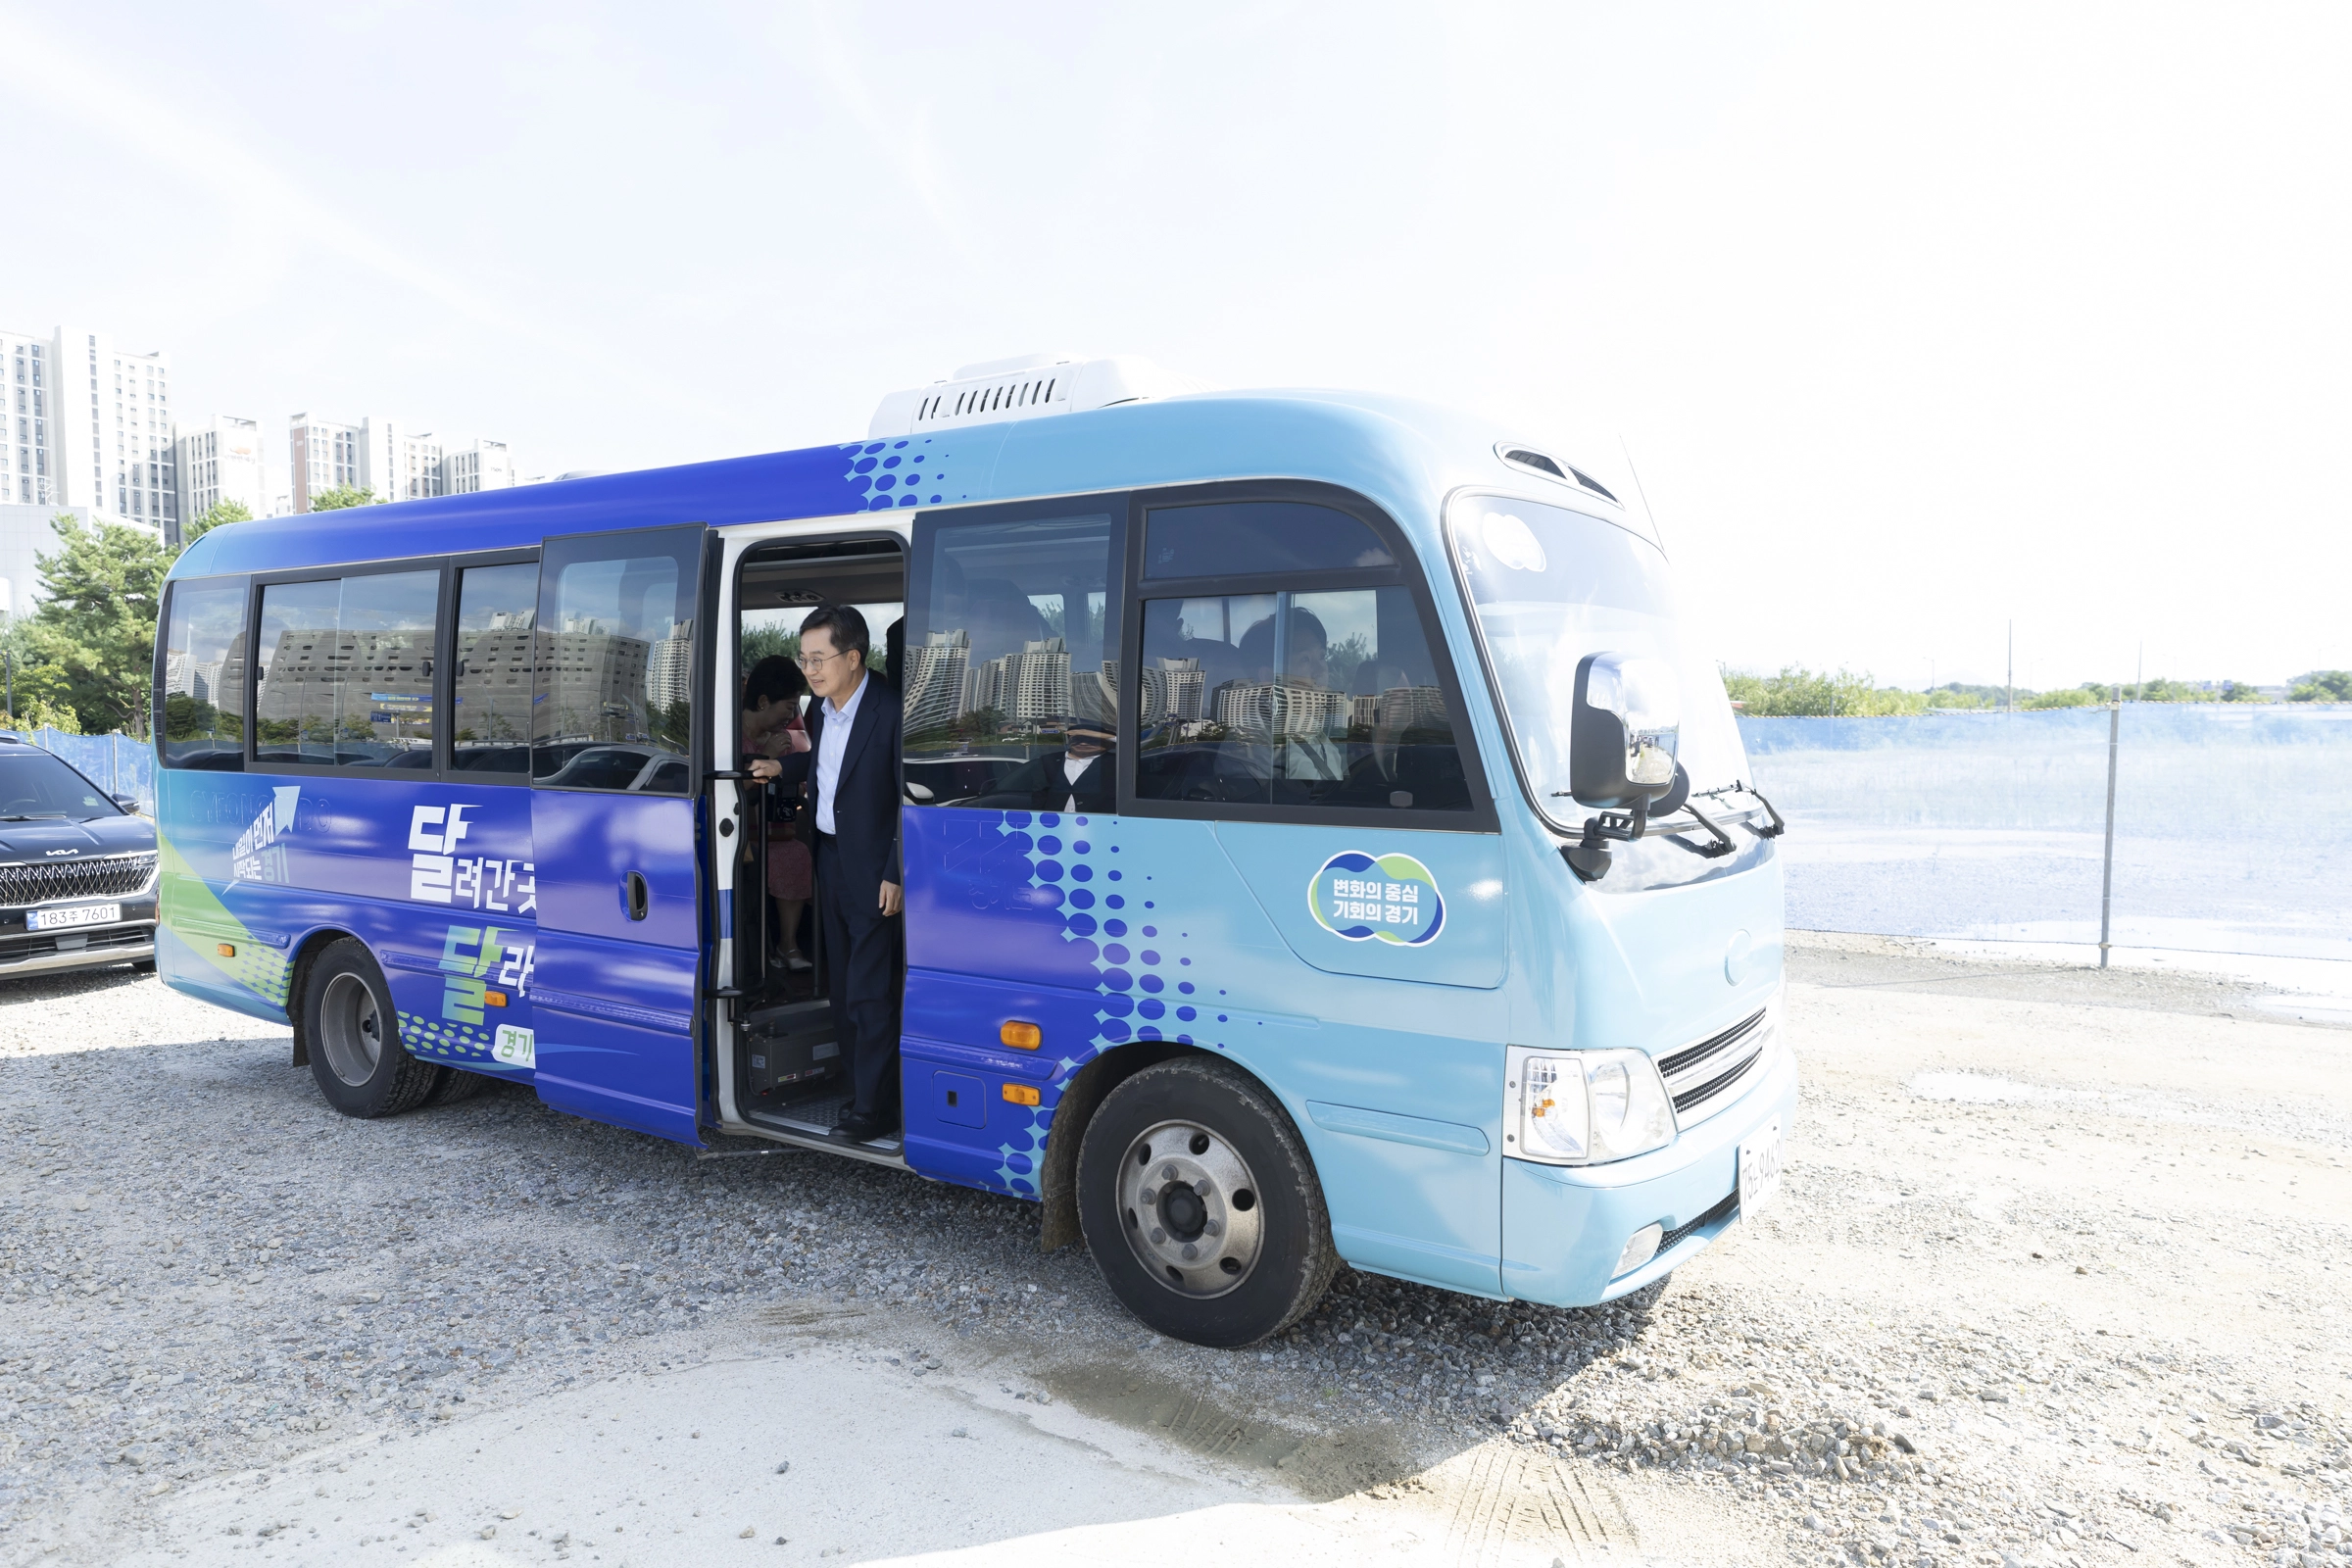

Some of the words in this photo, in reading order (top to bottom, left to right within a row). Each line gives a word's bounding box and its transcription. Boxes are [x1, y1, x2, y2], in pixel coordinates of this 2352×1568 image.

[232, 824, 254, 860] 내일이
[253, 801, 274, 851] 먼저
[261, 842, 290, 884] 경기
[1333, 878, 1382, 900] 변화의
[1385, 883, 1419, 904] 중심
[40, 910, 78, 926] 183주
[81, 906, 116, 921] 7601
[1333, 900, 1382, 922] 기회의
[1385, 904, 1419, 925] 경기
[501, 1029, 534, 1062] 경기
